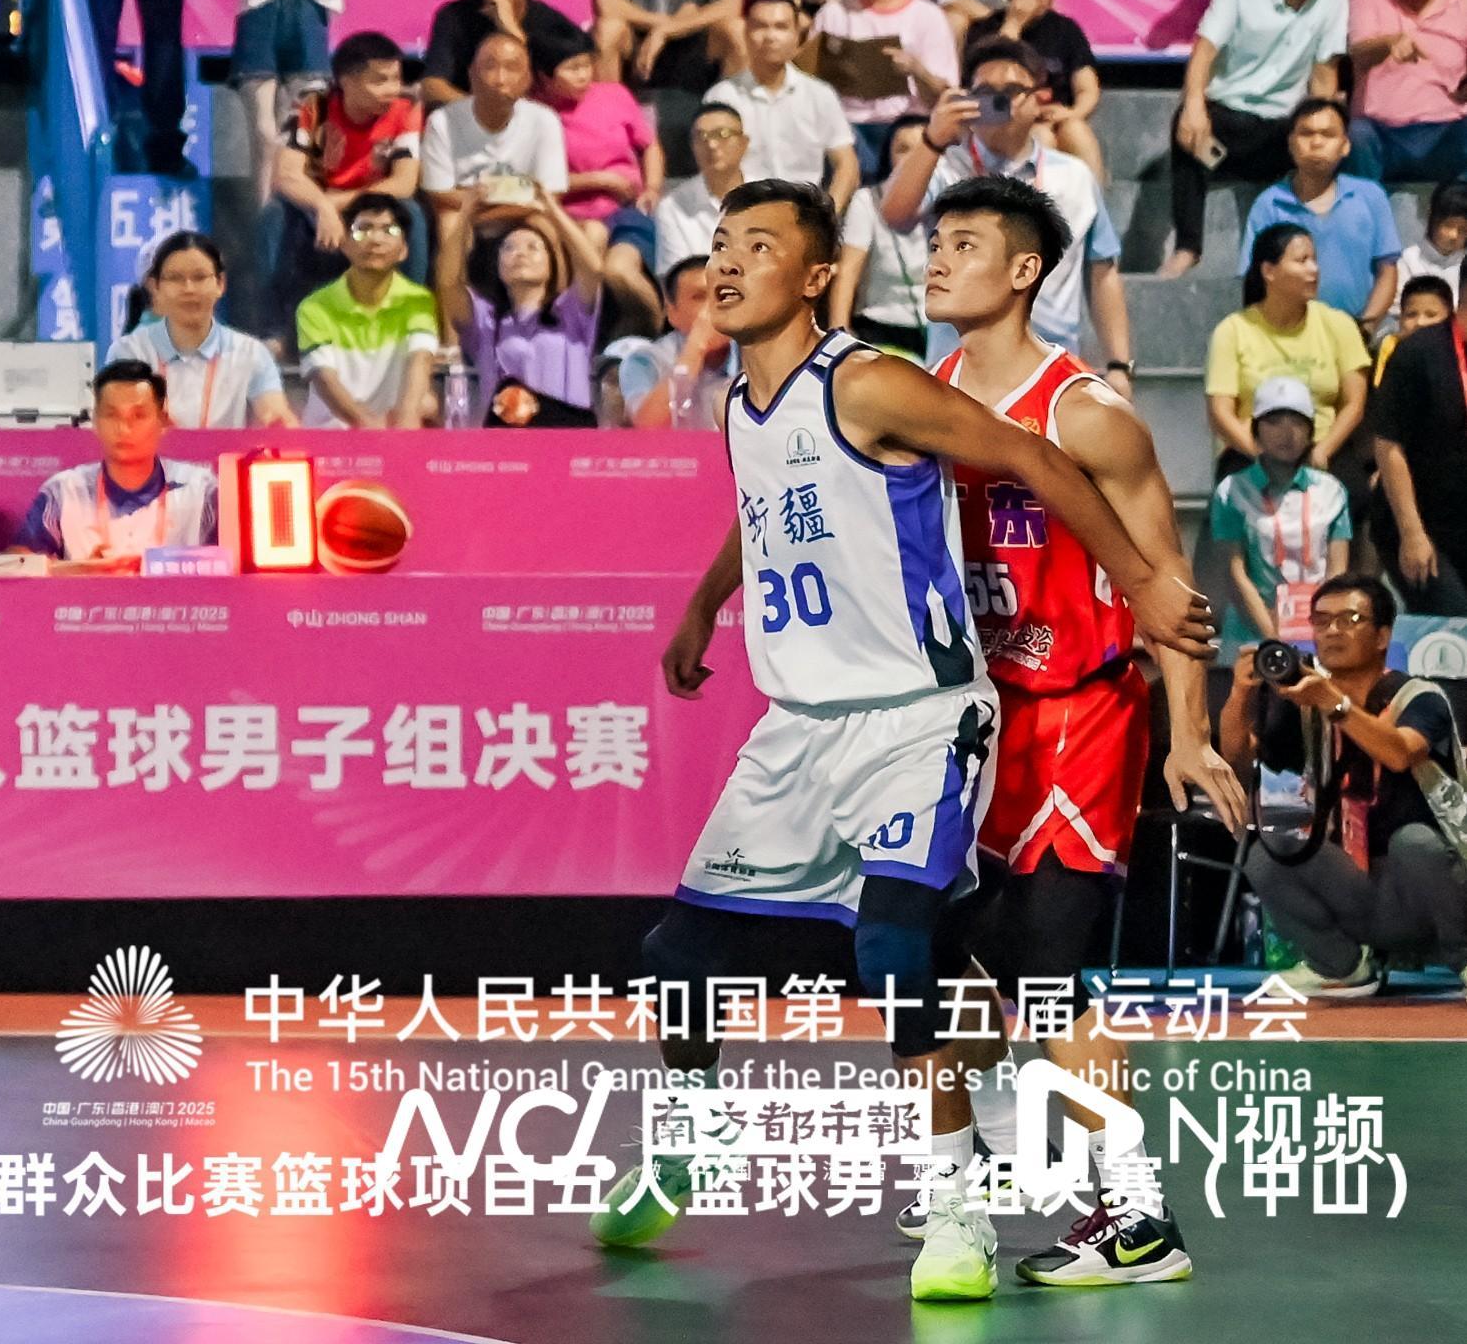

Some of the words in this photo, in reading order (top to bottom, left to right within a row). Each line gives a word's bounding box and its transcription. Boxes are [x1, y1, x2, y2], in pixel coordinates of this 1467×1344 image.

[248, 462, 315, 568] 0
[740, 482, 835, 557] 新疆
[758, 562, 834, 634] 30
[966, 561, 1019, 617] 55
